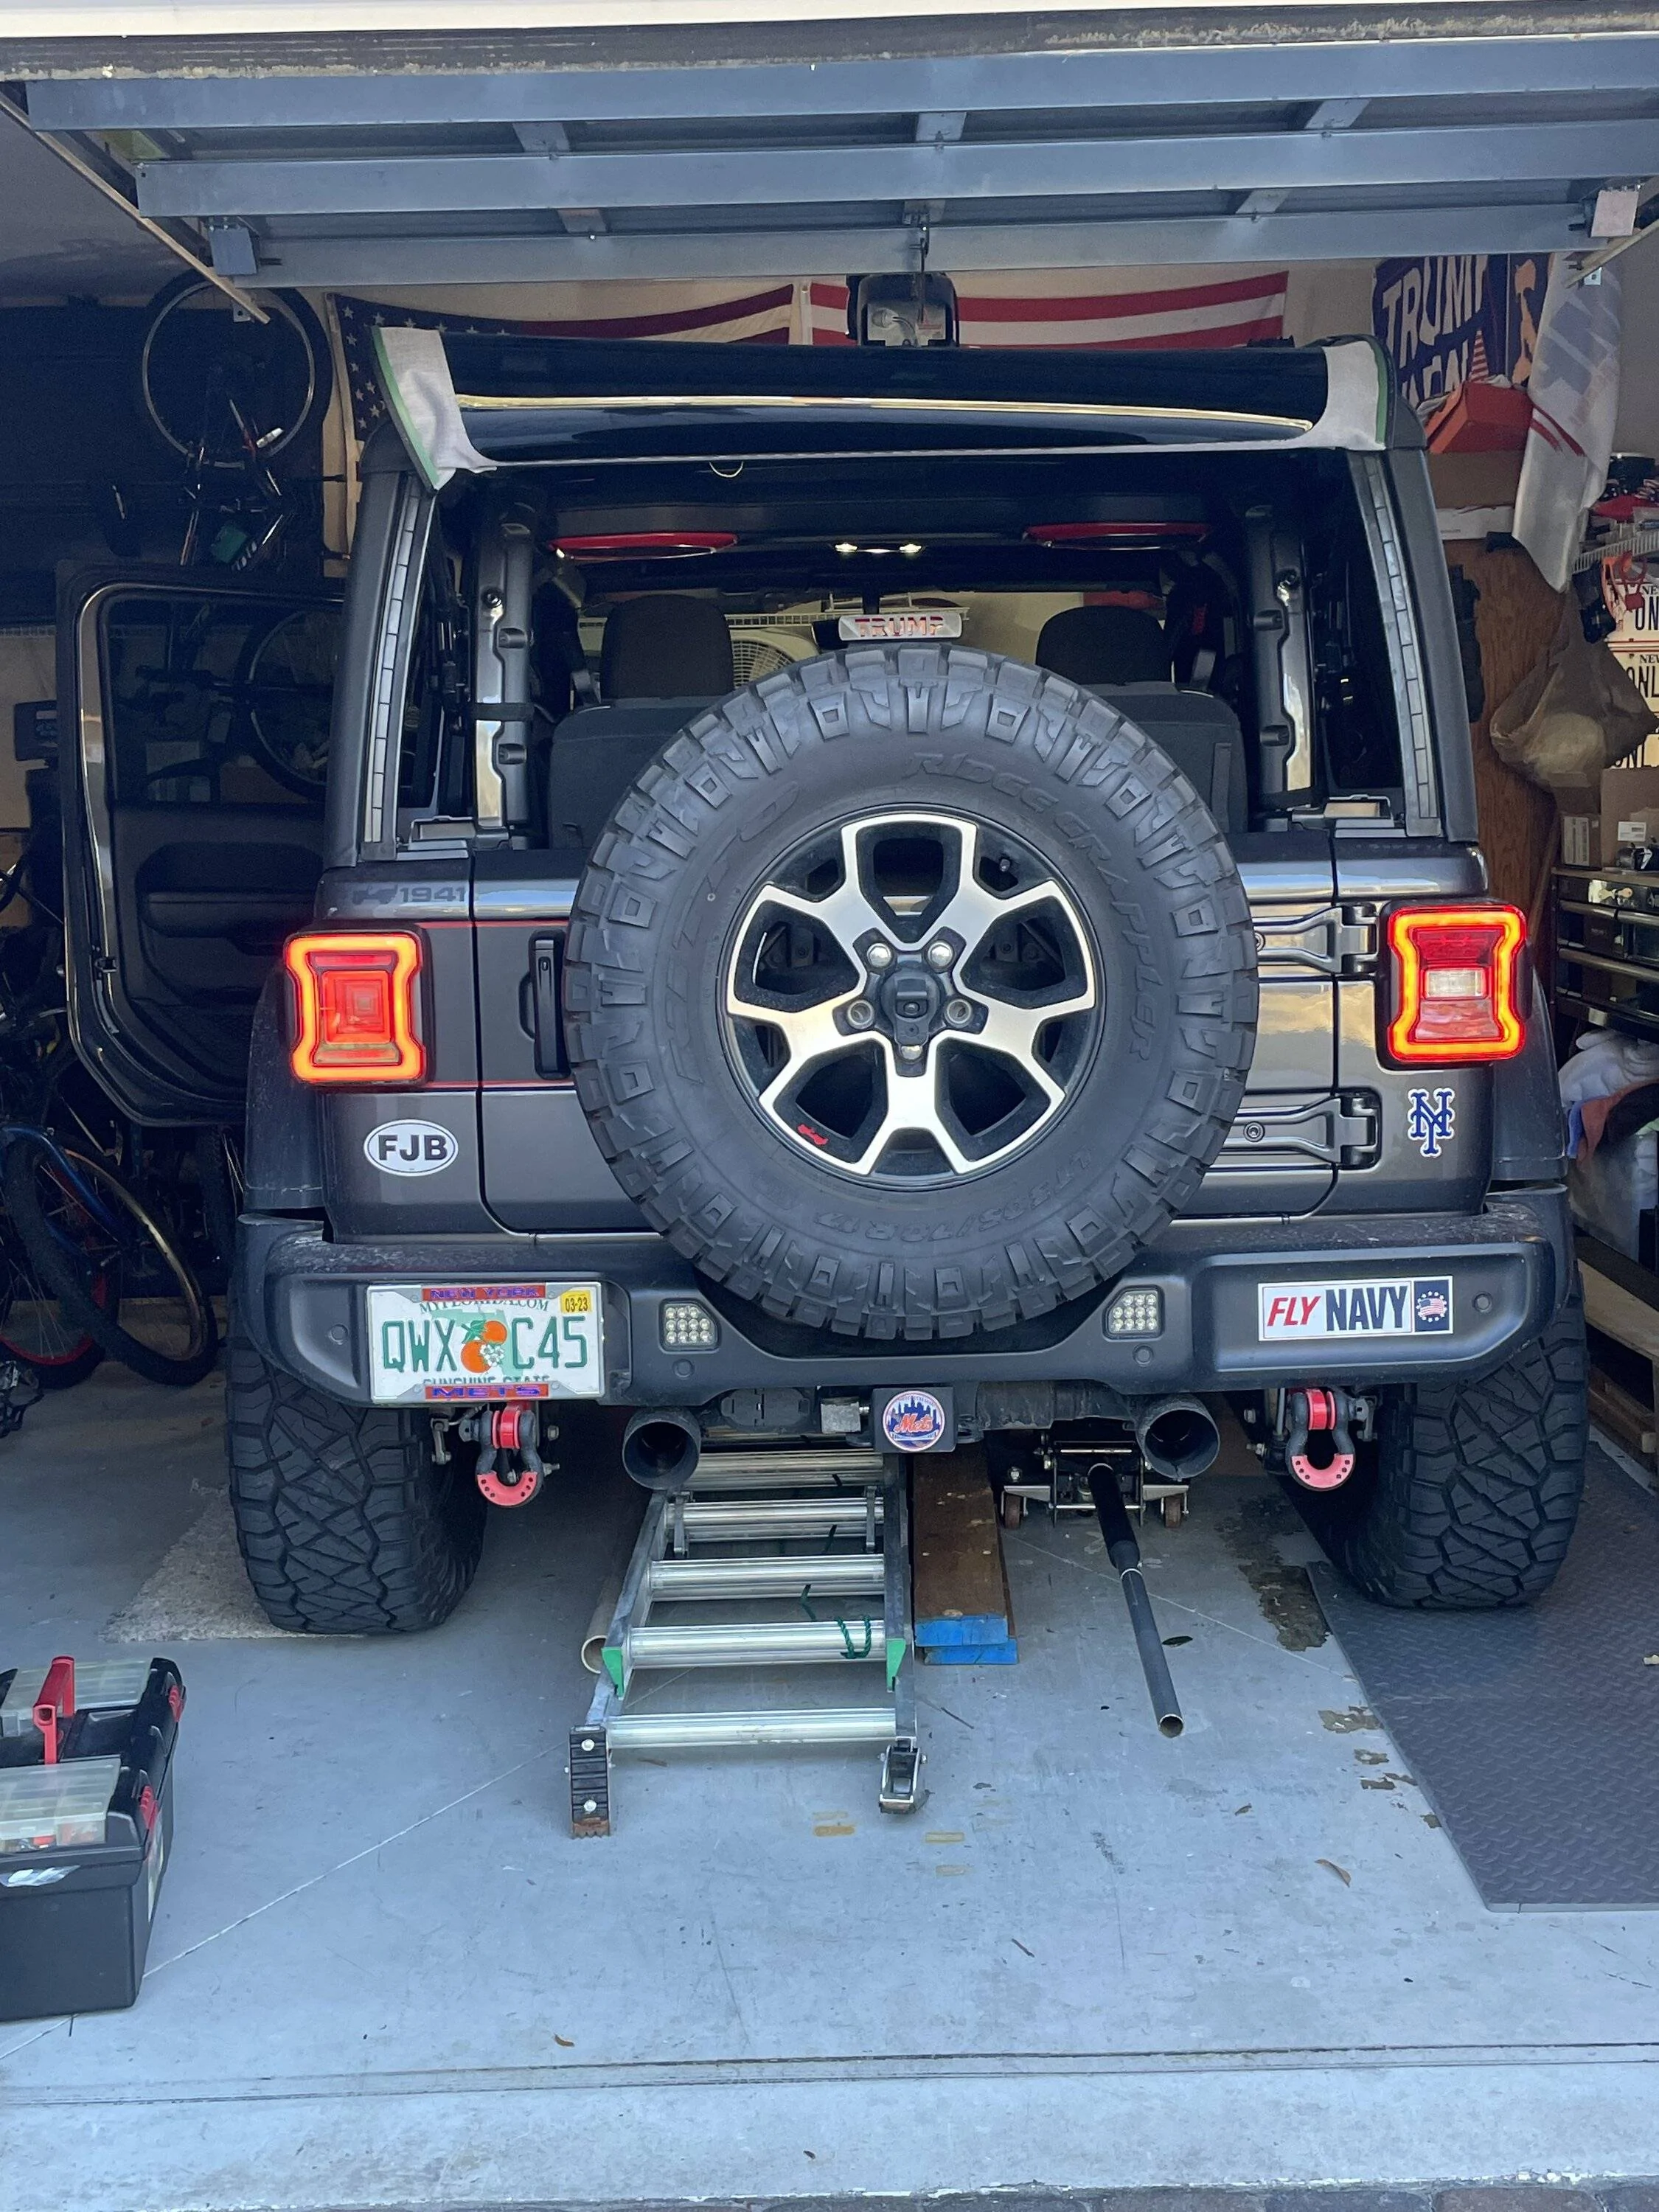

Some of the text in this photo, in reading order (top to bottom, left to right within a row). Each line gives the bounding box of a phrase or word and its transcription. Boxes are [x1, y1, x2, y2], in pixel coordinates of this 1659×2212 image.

[855, 616, 945, 637] TRUMP
[400, 886, 467, 902] 1941
[378, 1134, 448, 1161] FJB
[431, 1286, 539, 1300] NEW YORK
[1267, 1285, 1409, 1332] FLY NAVY
[381, 1315, 588, 1373] QWX C45
[432, 1385, 540, 1397] METS
[893, 1413, 933, 1433] Mets
